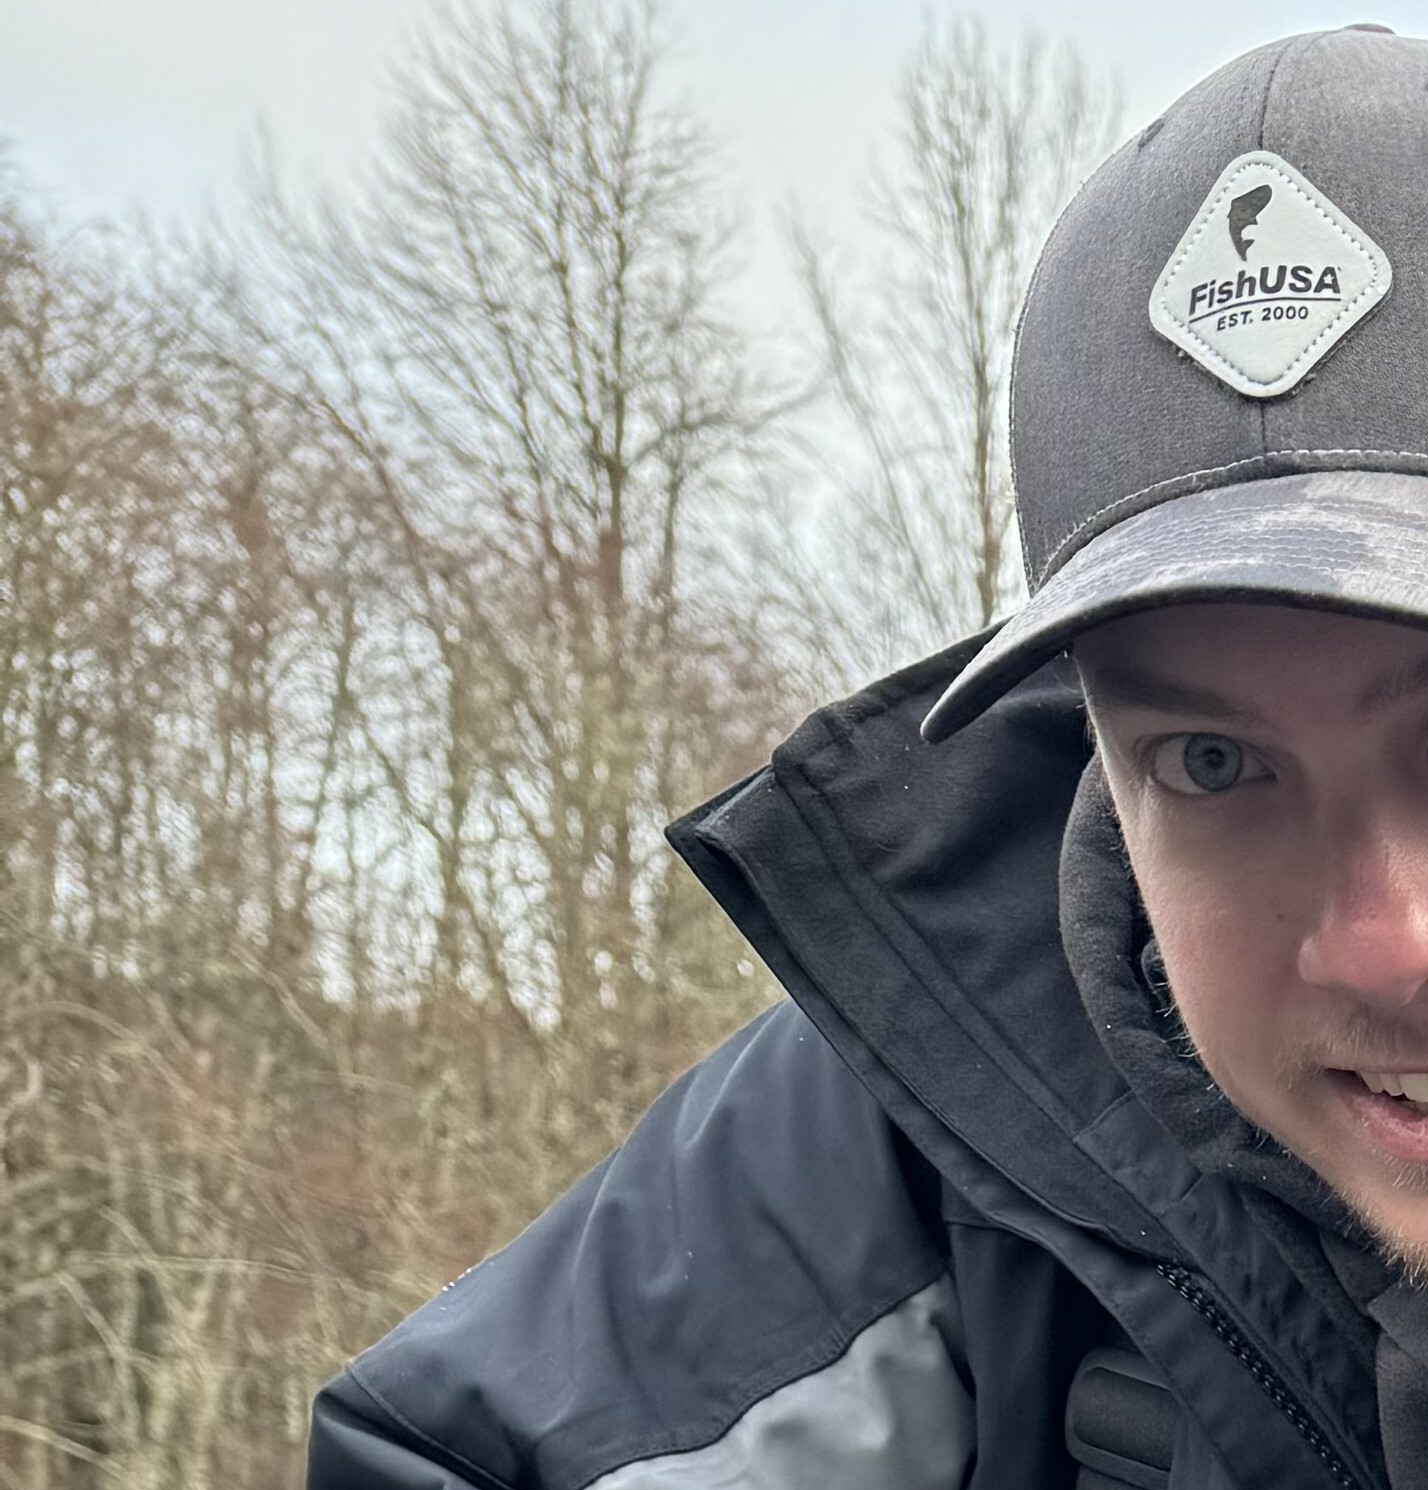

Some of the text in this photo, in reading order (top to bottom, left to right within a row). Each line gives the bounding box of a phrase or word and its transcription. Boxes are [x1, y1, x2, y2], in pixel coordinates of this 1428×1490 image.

[1188, 264, 1341, 316] FishUSA
[1216, 305, 1309, 331] EST. 2000
